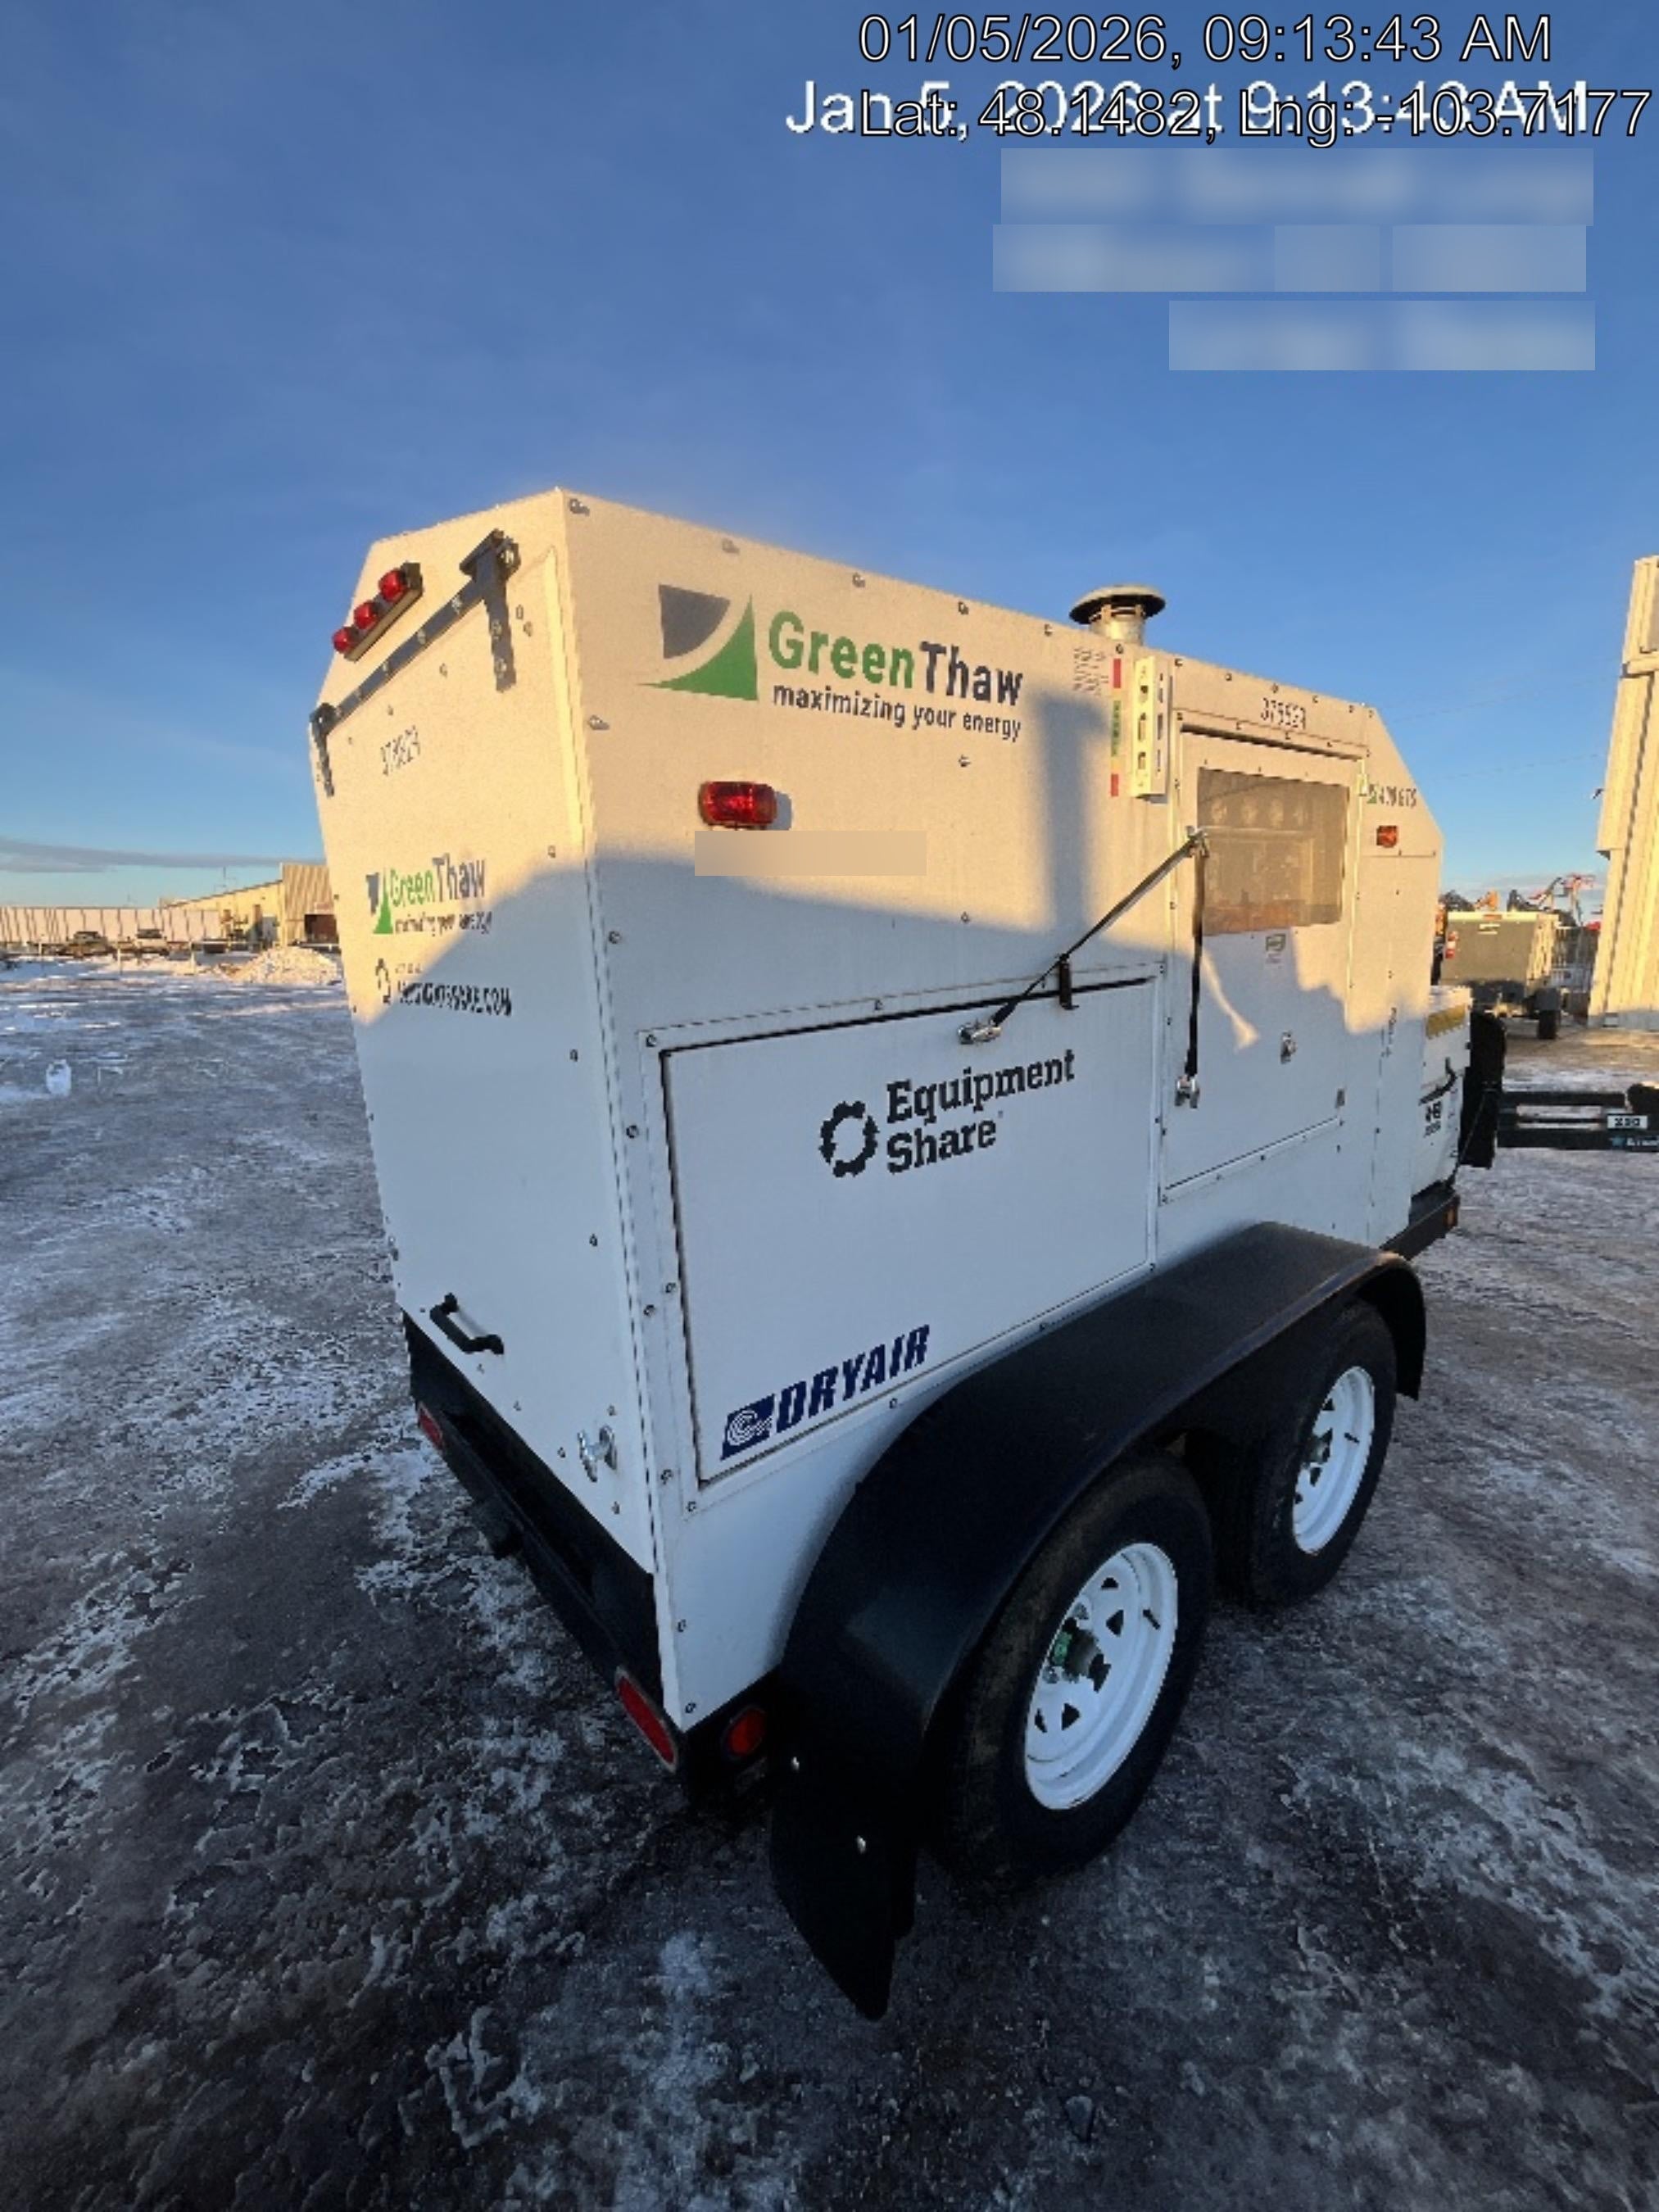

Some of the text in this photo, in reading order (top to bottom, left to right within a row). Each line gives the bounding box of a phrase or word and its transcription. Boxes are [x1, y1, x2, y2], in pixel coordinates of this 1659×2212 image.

[769, 610, 1023, 705] GreenThaw
[773, 685, 1022, 742] maximizing your energy
[390, 852, 485, 908] GreenThaw
[886, 1049, 1075, 1126] Equipment
[887, 1119, 996, 1174] Share
[776, 1324, 930, 1435] DRYAIR
